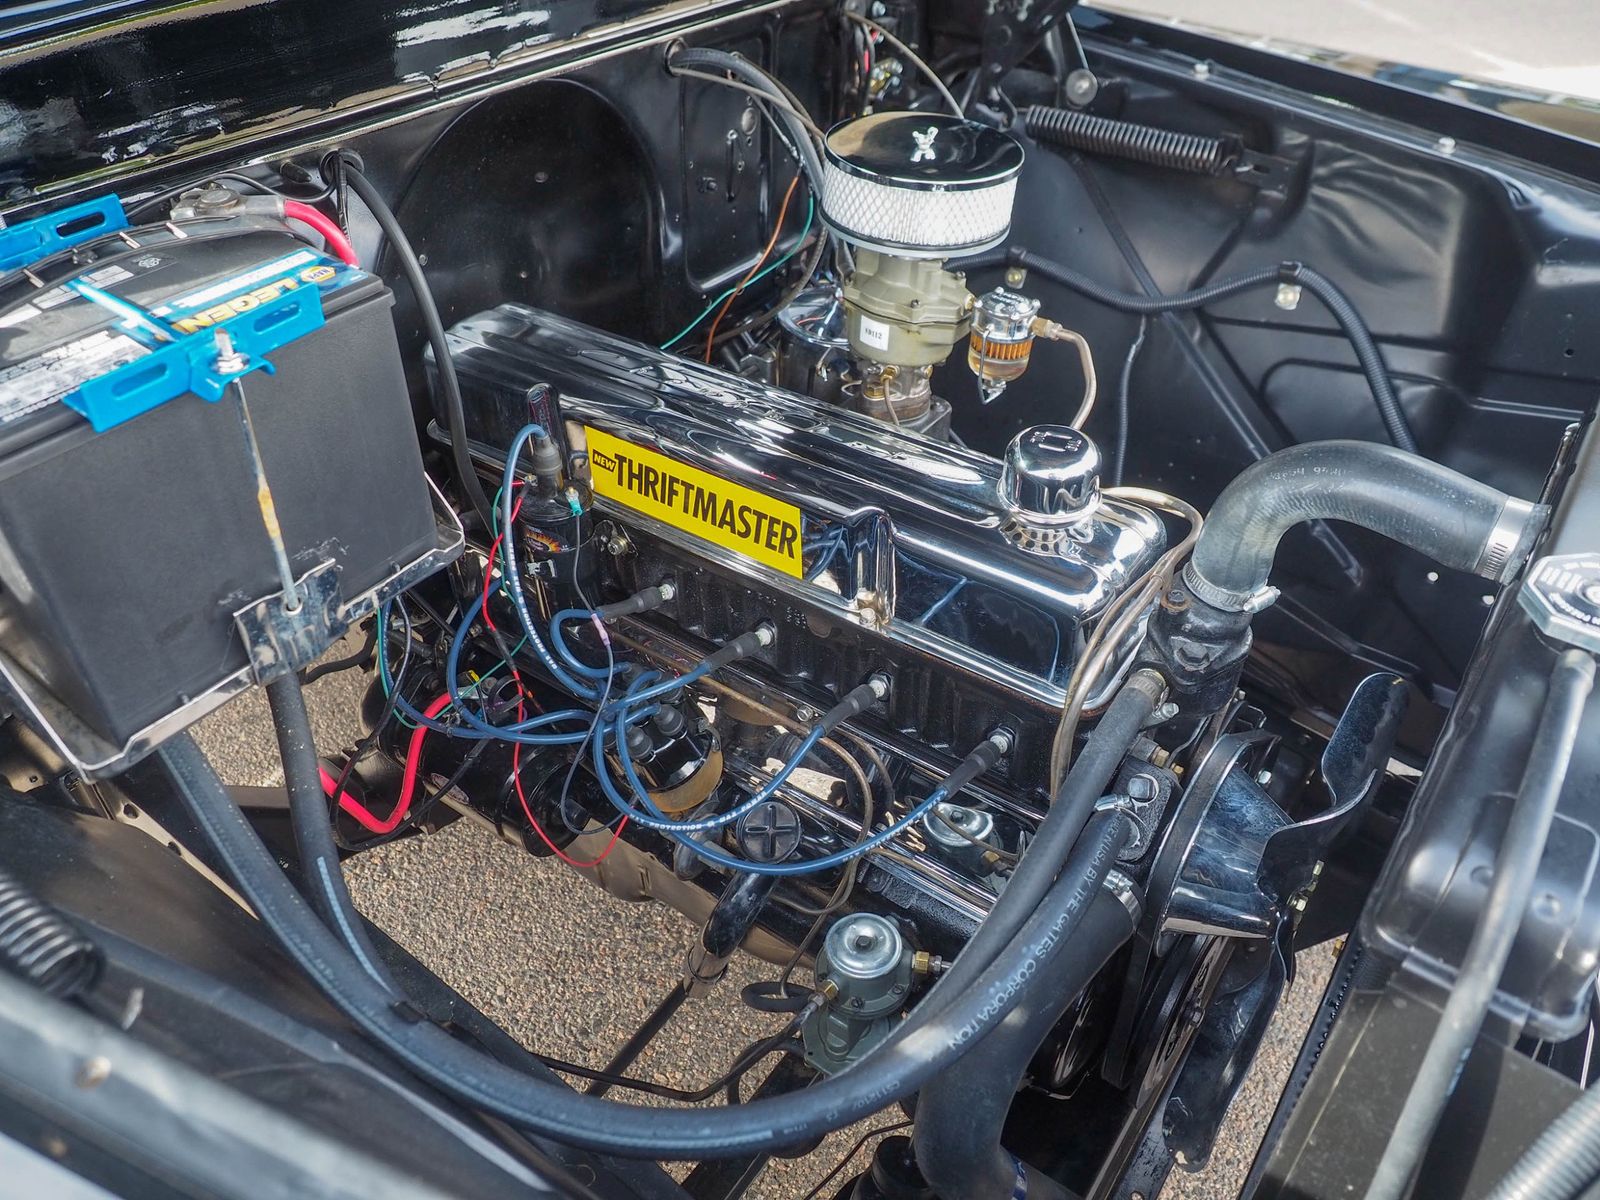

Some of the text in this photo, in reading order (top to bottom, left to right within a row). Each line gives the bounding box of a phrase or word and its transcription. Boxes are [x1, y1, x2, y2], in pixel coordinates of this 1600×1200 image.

[593, 453, 616, 472] NEW
[614, 453, 799, 560] THRIFTMASTER
[508, 542, 517, 571] POWER
[521, 608, 546, 653] PROTECTION
[649, 821, 703, 831] PROTECTION
[1092, 843, 1111, 866] USA
[1083, 866, 1098, 888] BY
[1066, 887, 1088, 913] THE
[1035, 913, 1070, 959] GATES
[948, 958, 1037, 1050] CORPORATION
